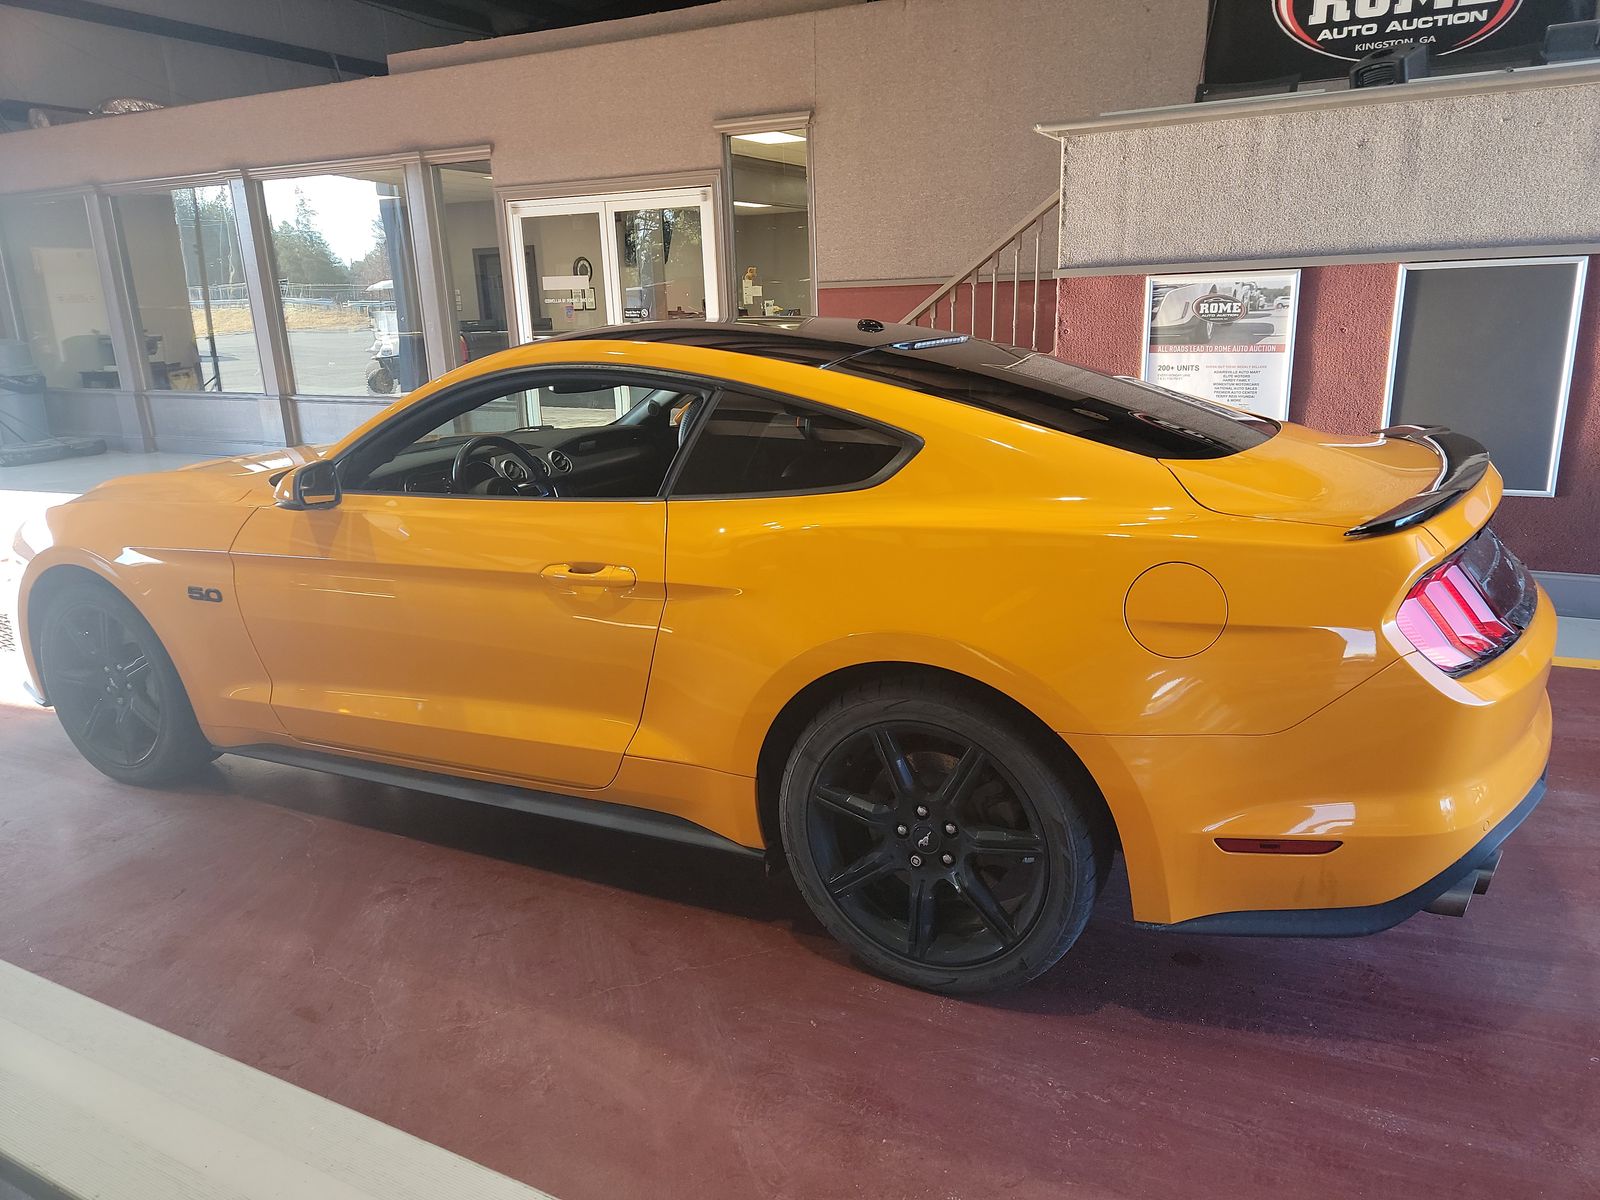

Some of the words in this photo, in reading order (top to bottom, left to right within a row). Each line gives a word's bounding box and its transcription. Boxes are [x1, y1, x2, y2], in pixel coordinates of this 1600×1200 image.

[1316, 23, 1378, 42] AUTO
[1385, 9, 1489, 33] AUCTION
[1420, 35, 1437, 44] GA
[1199, 302, 1242, 314] ROME
